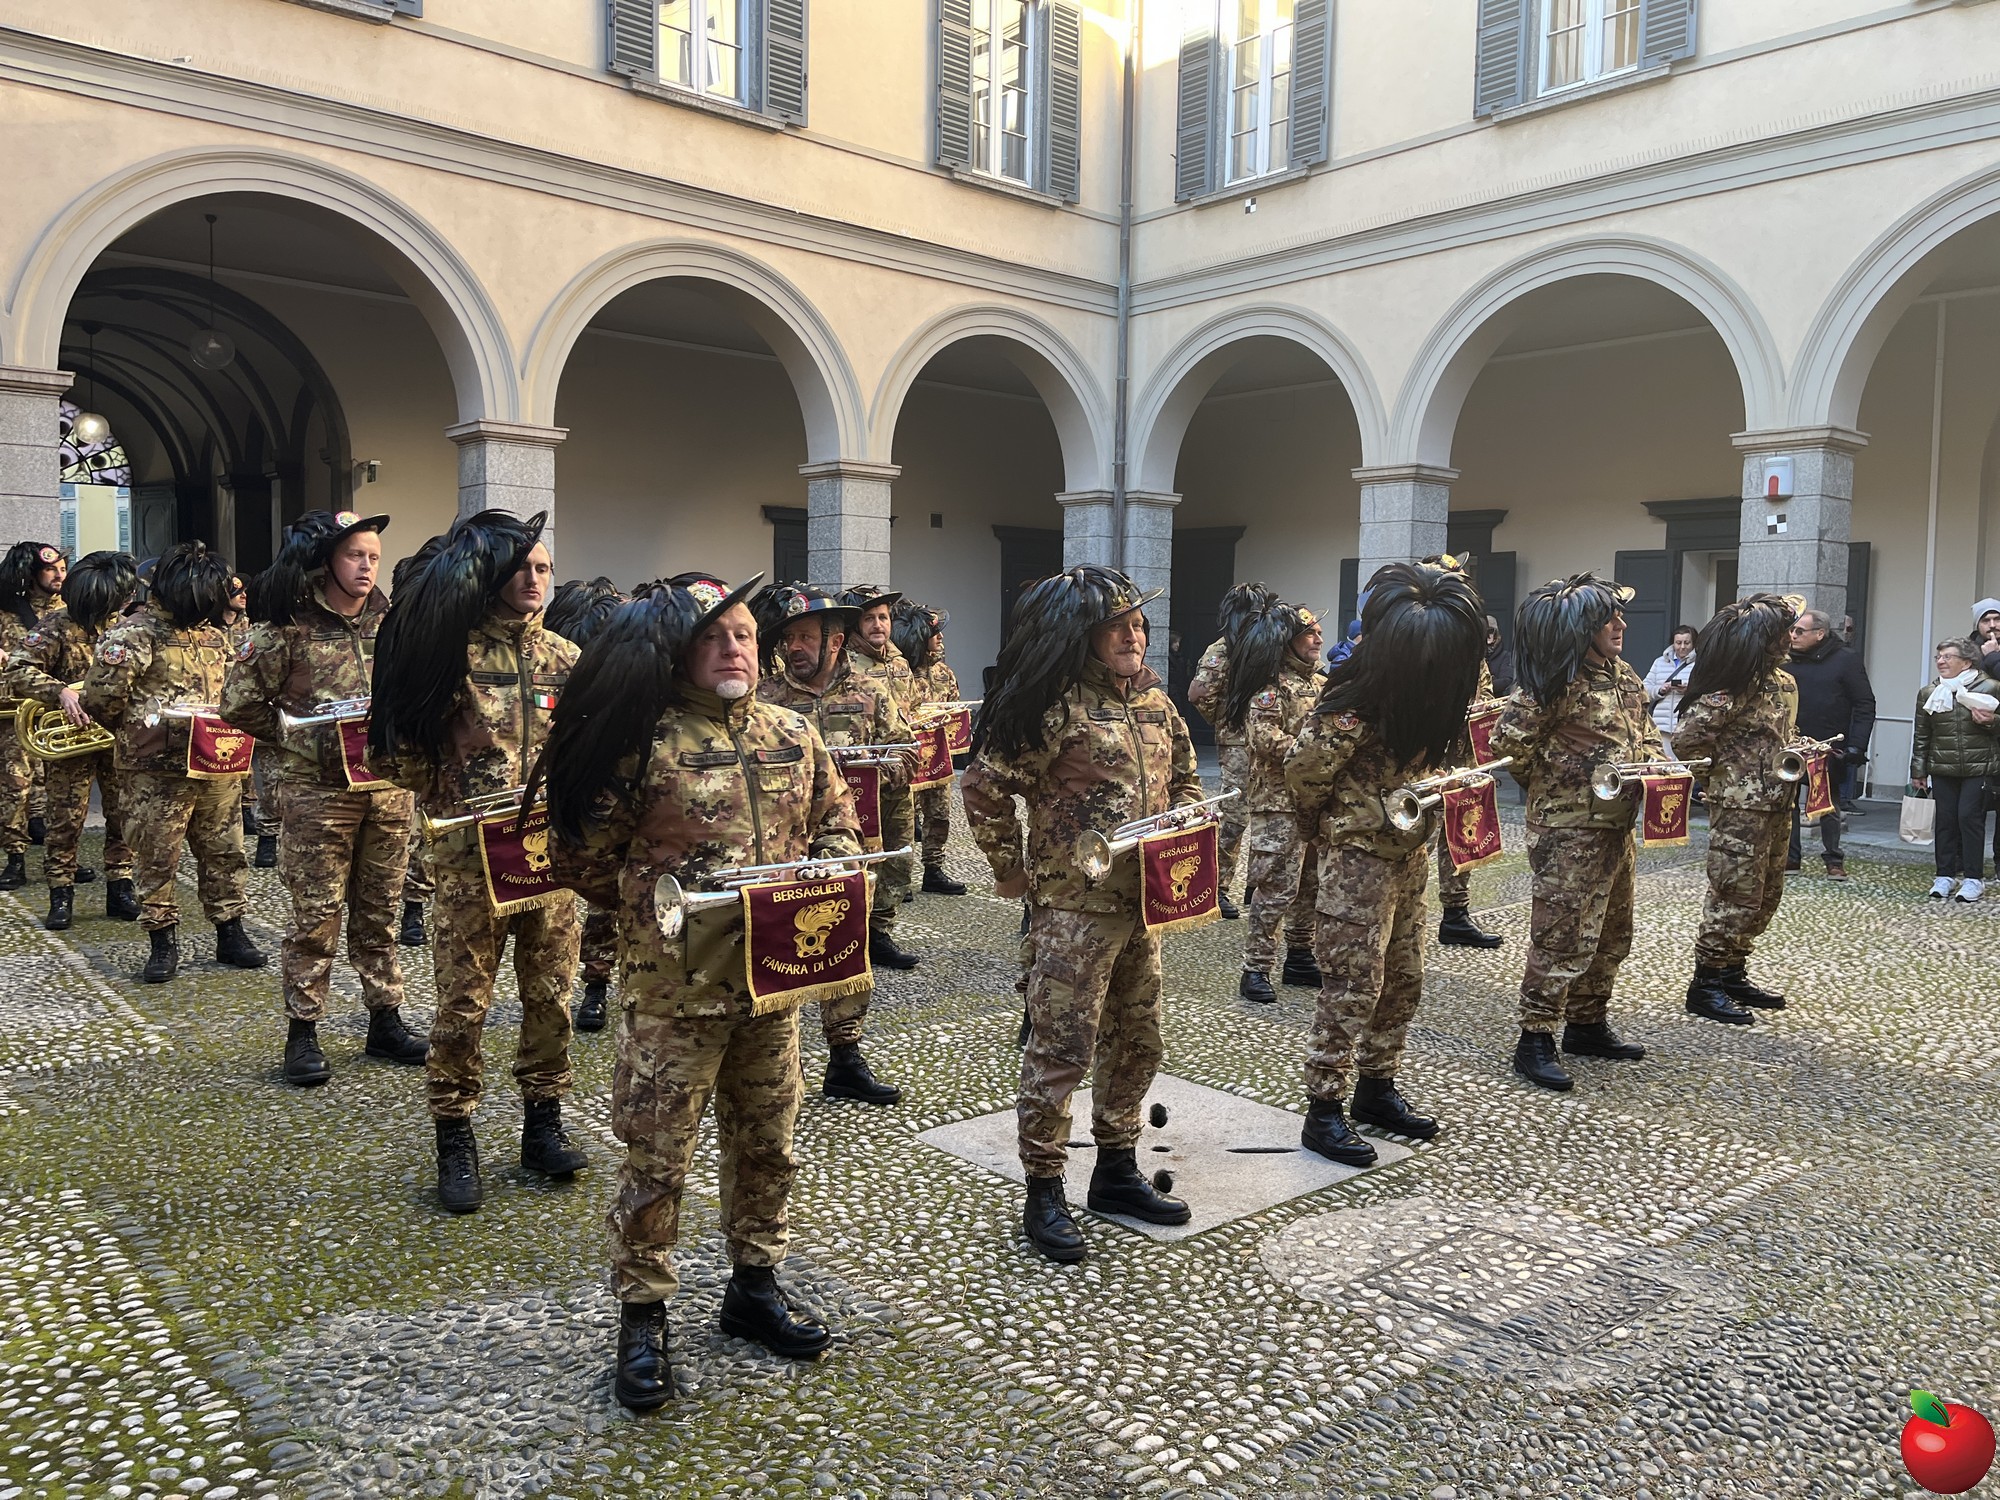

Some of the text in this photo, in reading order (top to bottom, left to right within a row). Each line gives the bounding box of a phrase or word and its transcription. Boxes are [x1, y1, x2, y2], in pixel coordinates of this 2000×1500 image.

[1159, 842, 1199, 859] BERSAGLIERI
[500, 872, 542, 885] FANFARA
[772, 881, 845, 903] BERSAGLIERI
[1150, 887, 1212, 914] FANFARA DI LECCO
[762, 939, 859, 975] FANFARA DI LECCO
